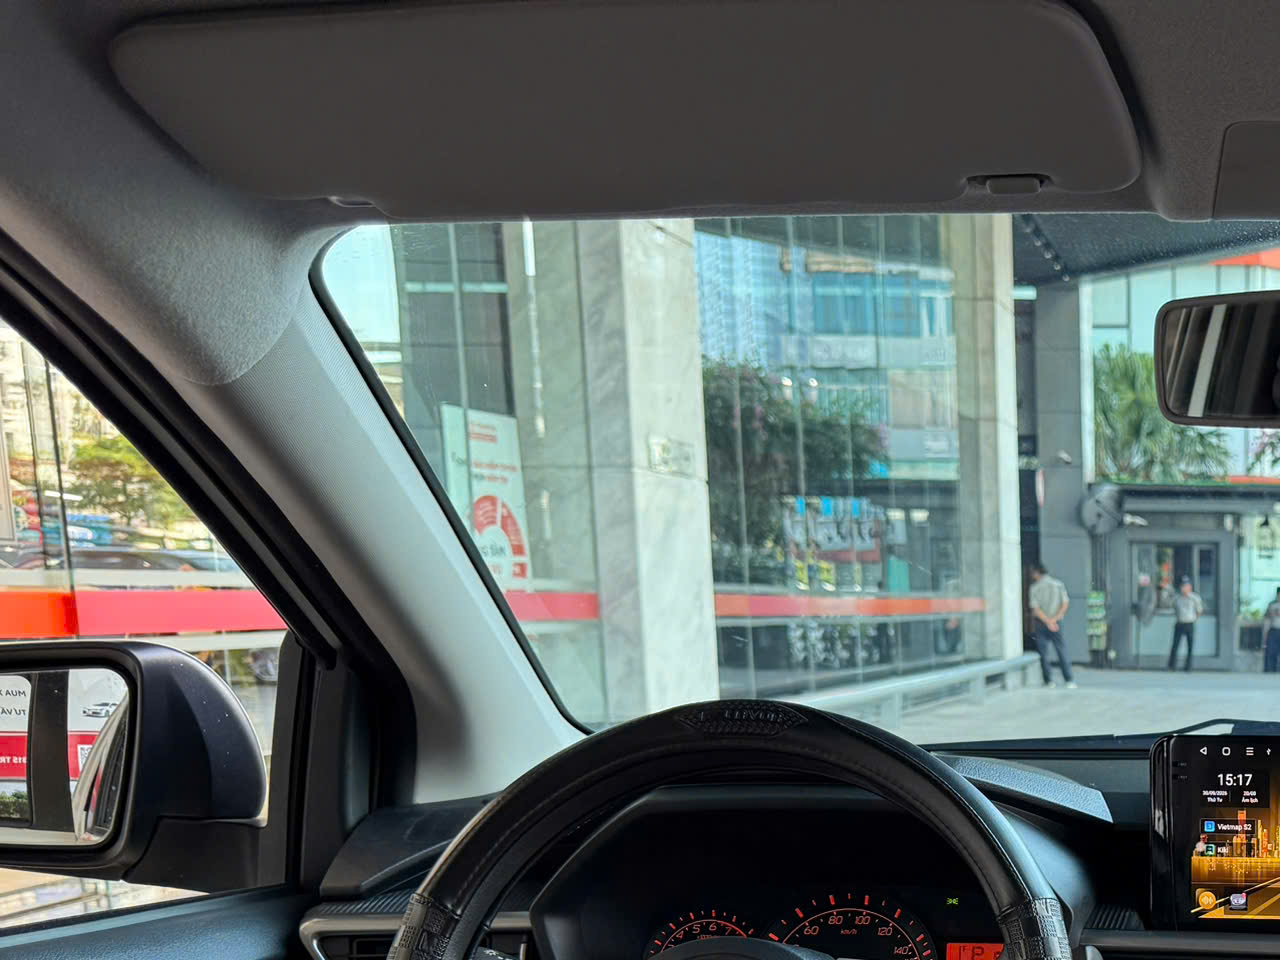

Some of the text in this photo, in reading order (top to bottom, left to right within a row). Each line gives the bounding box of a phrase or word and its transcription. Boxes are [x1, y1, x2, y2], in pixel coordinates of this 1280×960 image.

[1217, 773, 1253, 786] 15:17
[1217, 823, 1243, 831] Vietmap
[828, 915, 844, 925] 80
[855, 915, 871, 925] 100
[692, 924, 701, 934] 5
[708, 921, 717, 932] 6
[803, 925, 820, 935] 60
[877, 926, 893, 936] 120
[893, 945, 909, 955] 140
